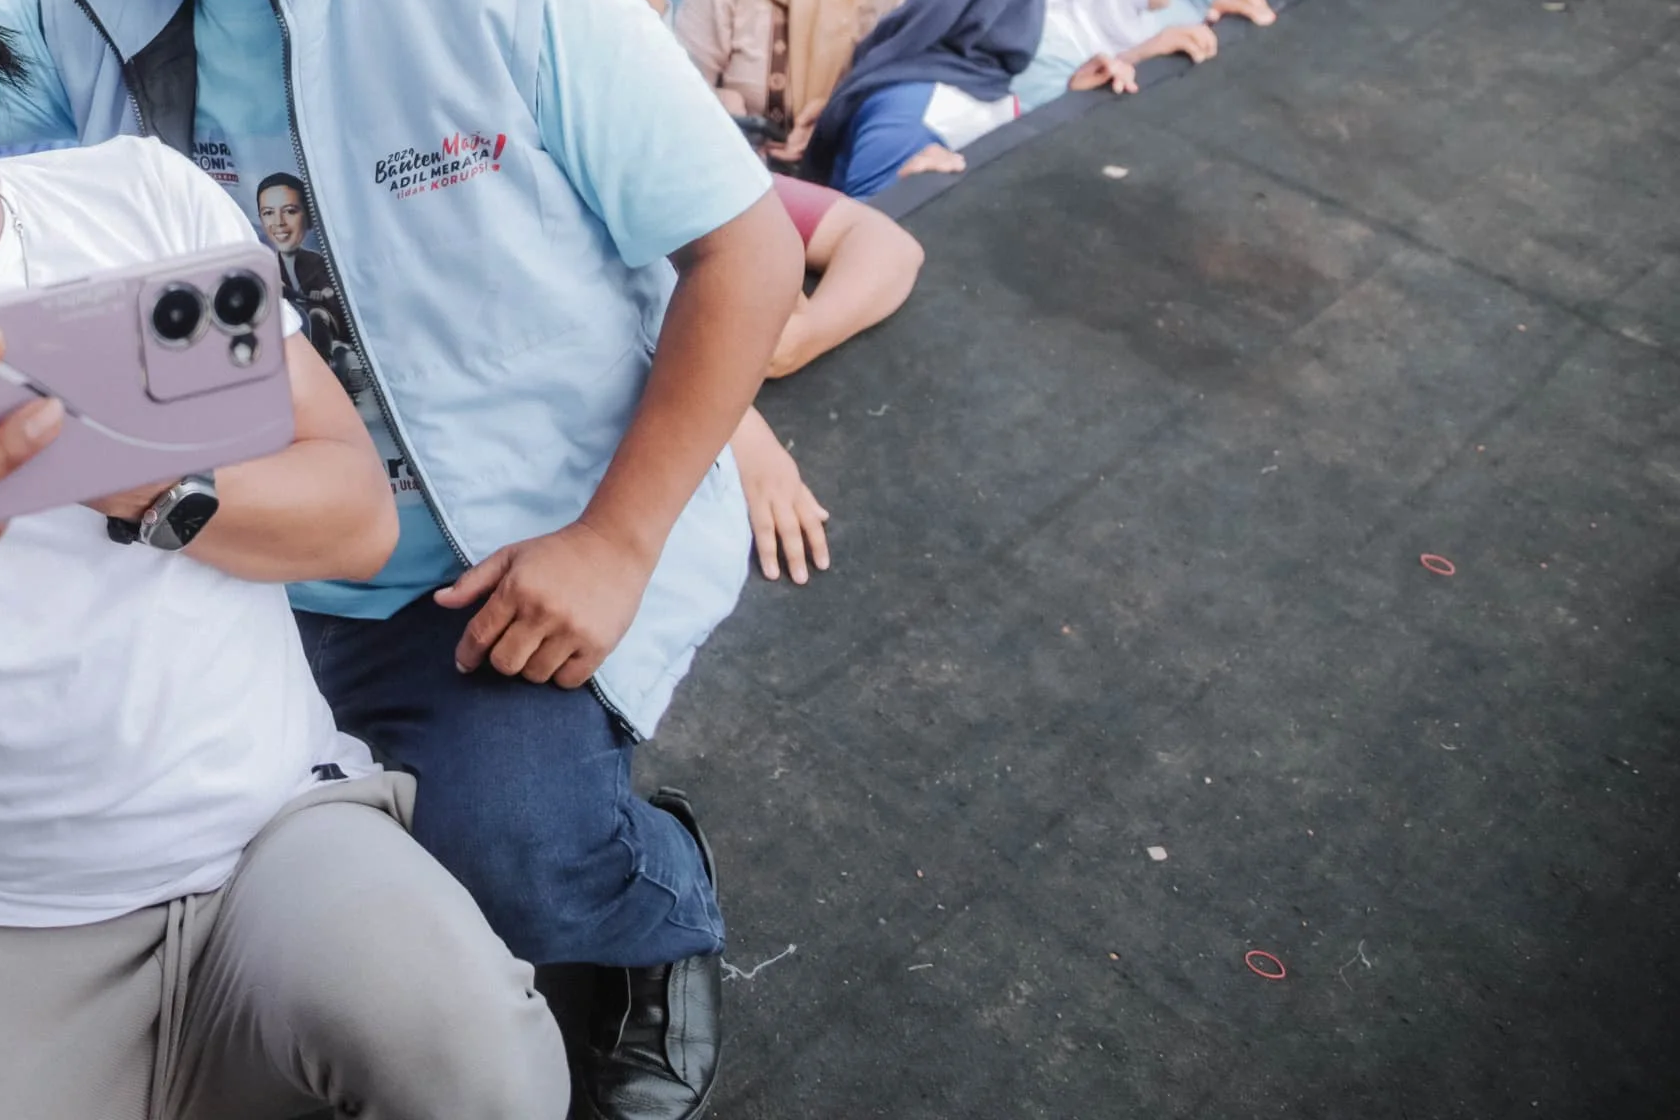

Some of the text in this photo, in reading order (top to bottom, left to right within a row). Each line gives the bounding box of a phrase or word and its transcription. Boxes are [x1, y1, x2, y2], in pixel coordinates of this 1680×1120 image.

[375, 151, 442, 184] Banten
[389, 148, 490, 192] ADIL MERATA
[430, 161, 488, 191] KORUPSI
